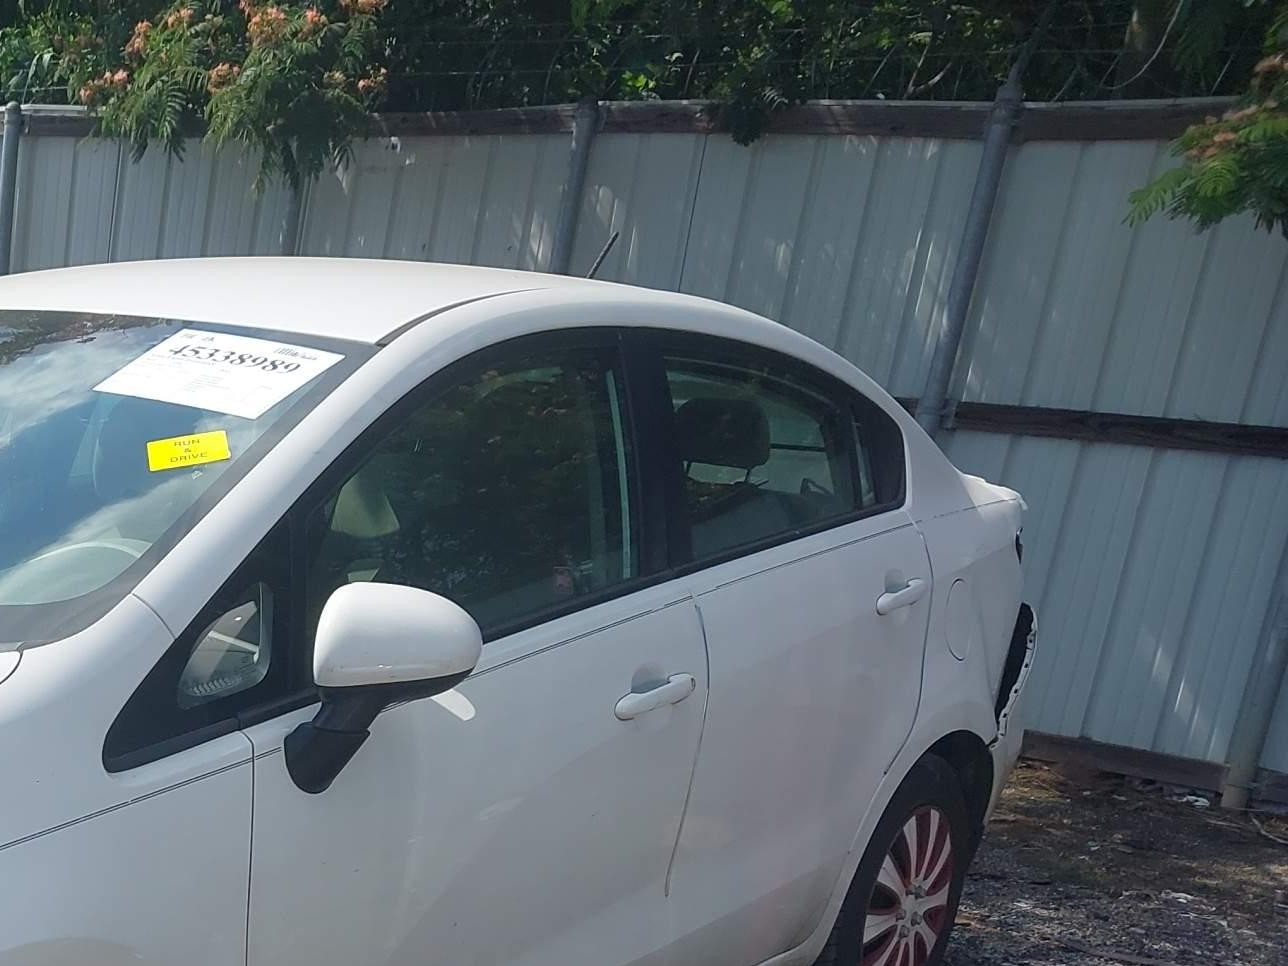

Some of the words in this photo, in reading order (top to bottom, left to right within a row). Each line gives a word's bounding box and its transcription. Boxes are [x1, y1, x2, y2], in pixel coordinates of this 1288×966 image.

[168, 344, 301, 374] 45338989
[173, 439, 200, 447] RUN
[170, 452, 208, 463] DRIVE
